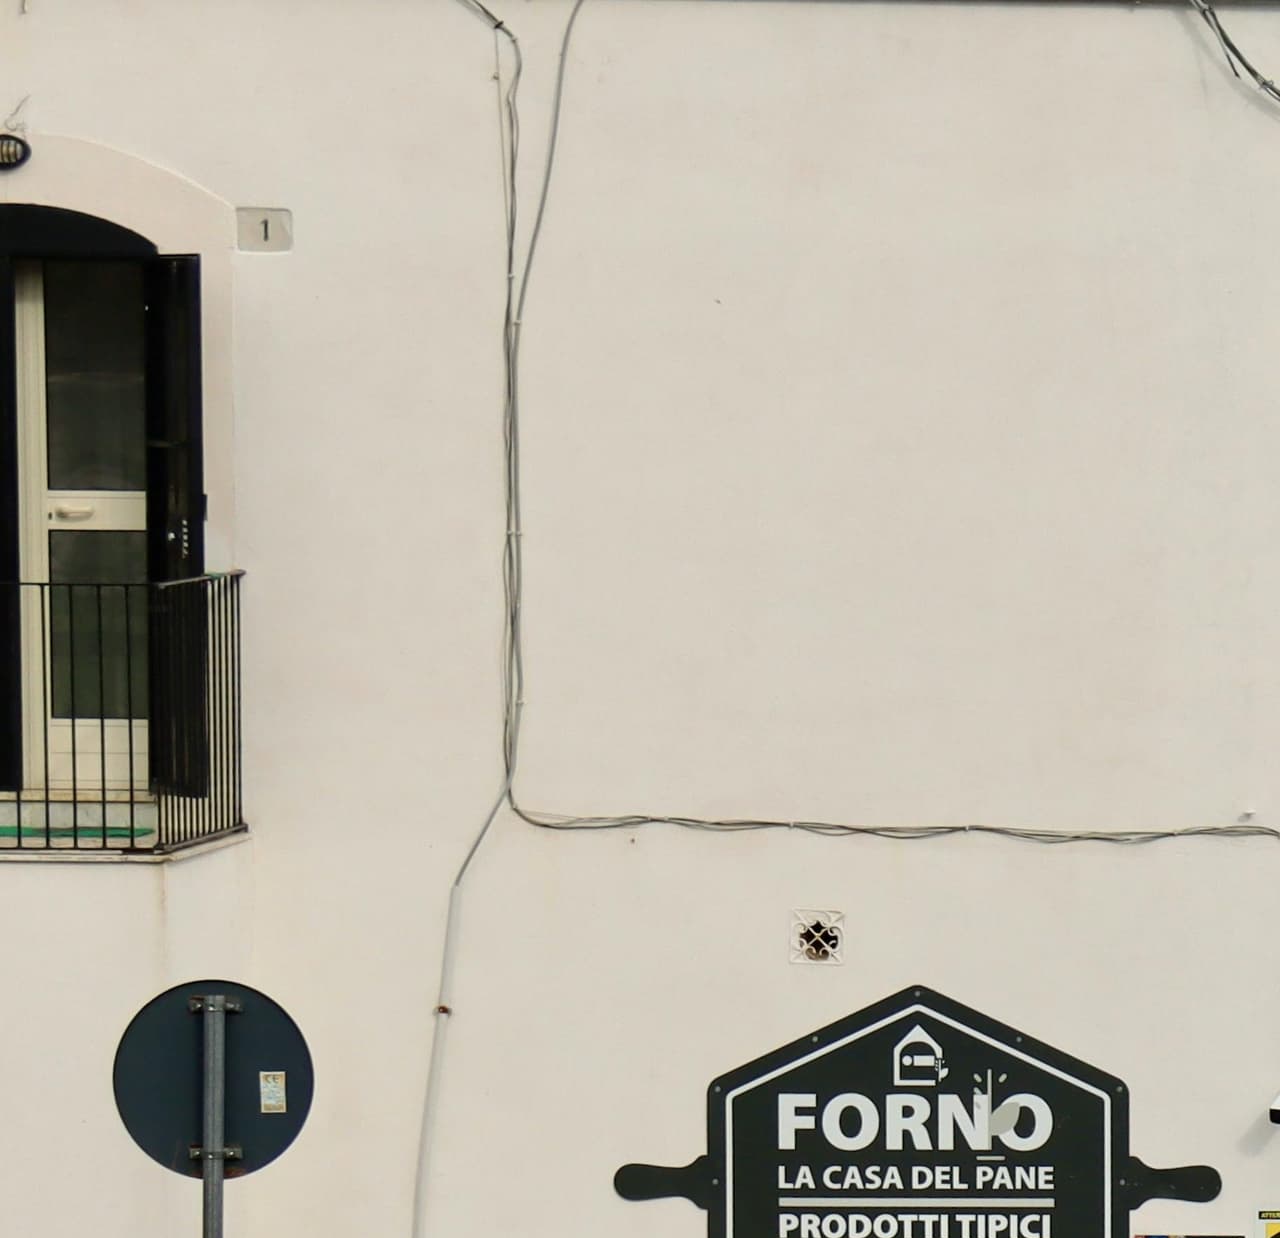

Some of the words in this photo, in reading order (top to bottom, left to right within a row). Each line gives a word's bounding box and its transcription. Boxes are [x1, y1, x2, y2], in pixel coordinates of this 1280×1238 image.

[260, 219, 268, 242] 1
[778, 1093, 1055, 1151] FORNO
[779, 1166, 815, 1188] LA
[823, 1166, 903, 1189] CASA
[912, 1166, 968, 1189] DEL
[976, 1166, 1054, 1189] PANE
[779, 1214, 948, 1238] PRODOTTI
[956, 1215, 1050, 1238] TIPICI
